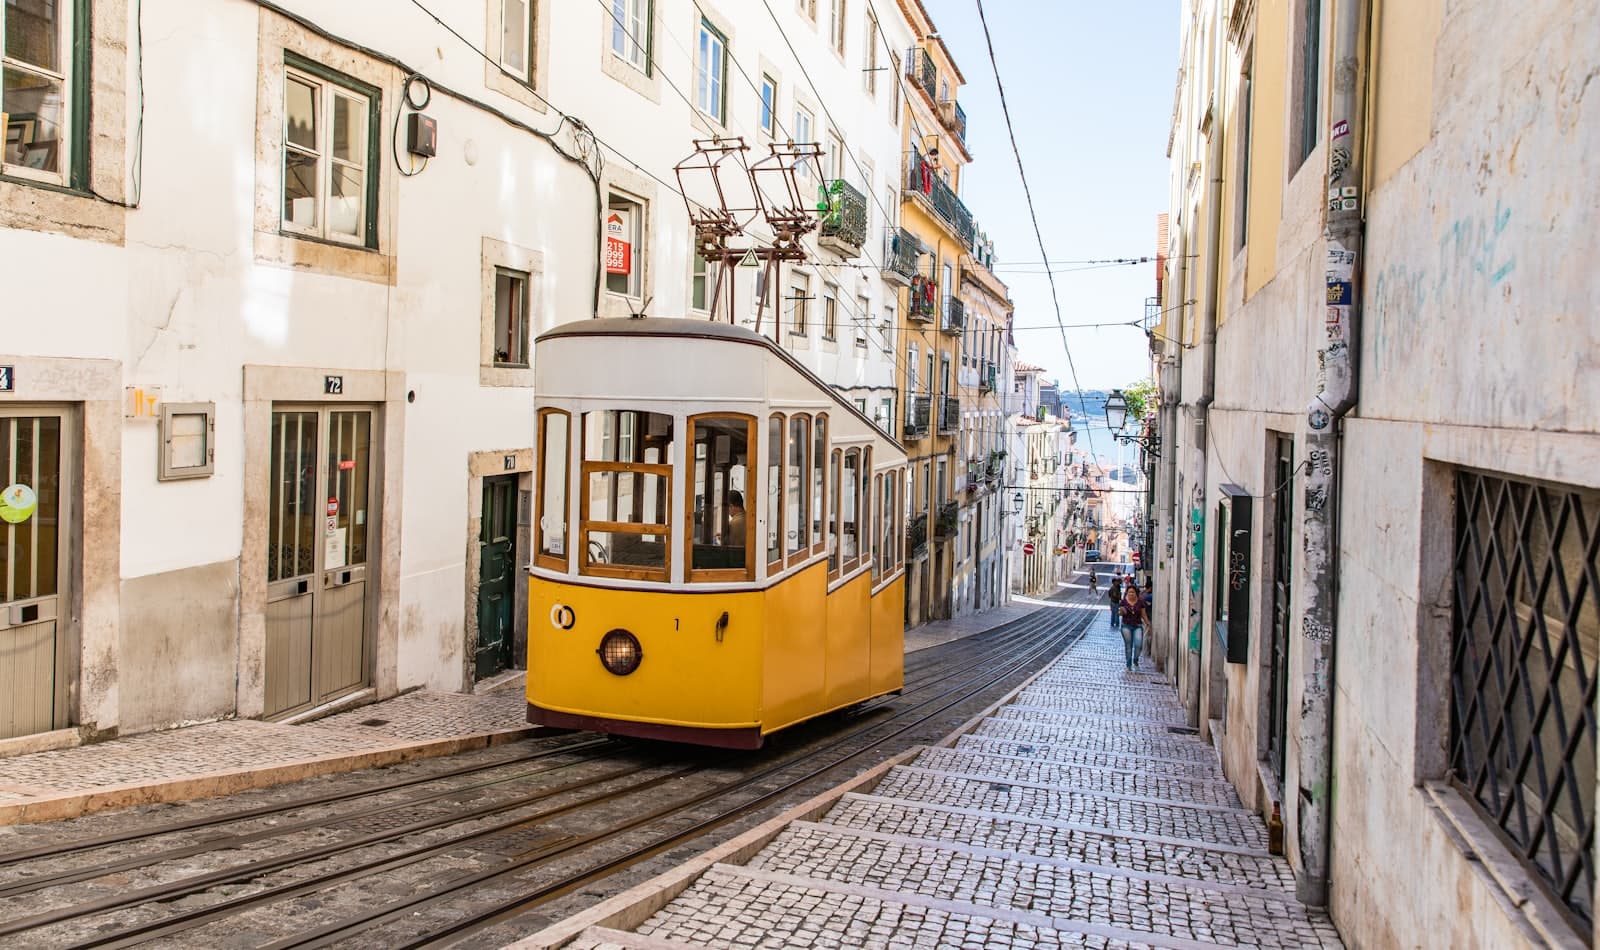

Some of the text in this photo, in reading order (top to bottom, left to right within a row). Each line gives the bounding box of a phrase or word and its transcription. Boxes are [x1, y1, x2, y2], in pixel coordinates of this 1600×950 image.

[607, 242, 624, 251] 215
[607, 250, 624, 259] 999
[607, 259, 624, 268] 995
[328, 376, 341, 393] 72
[506, 456, 515, 470] 71
[674, 618, 680, 632] 1
